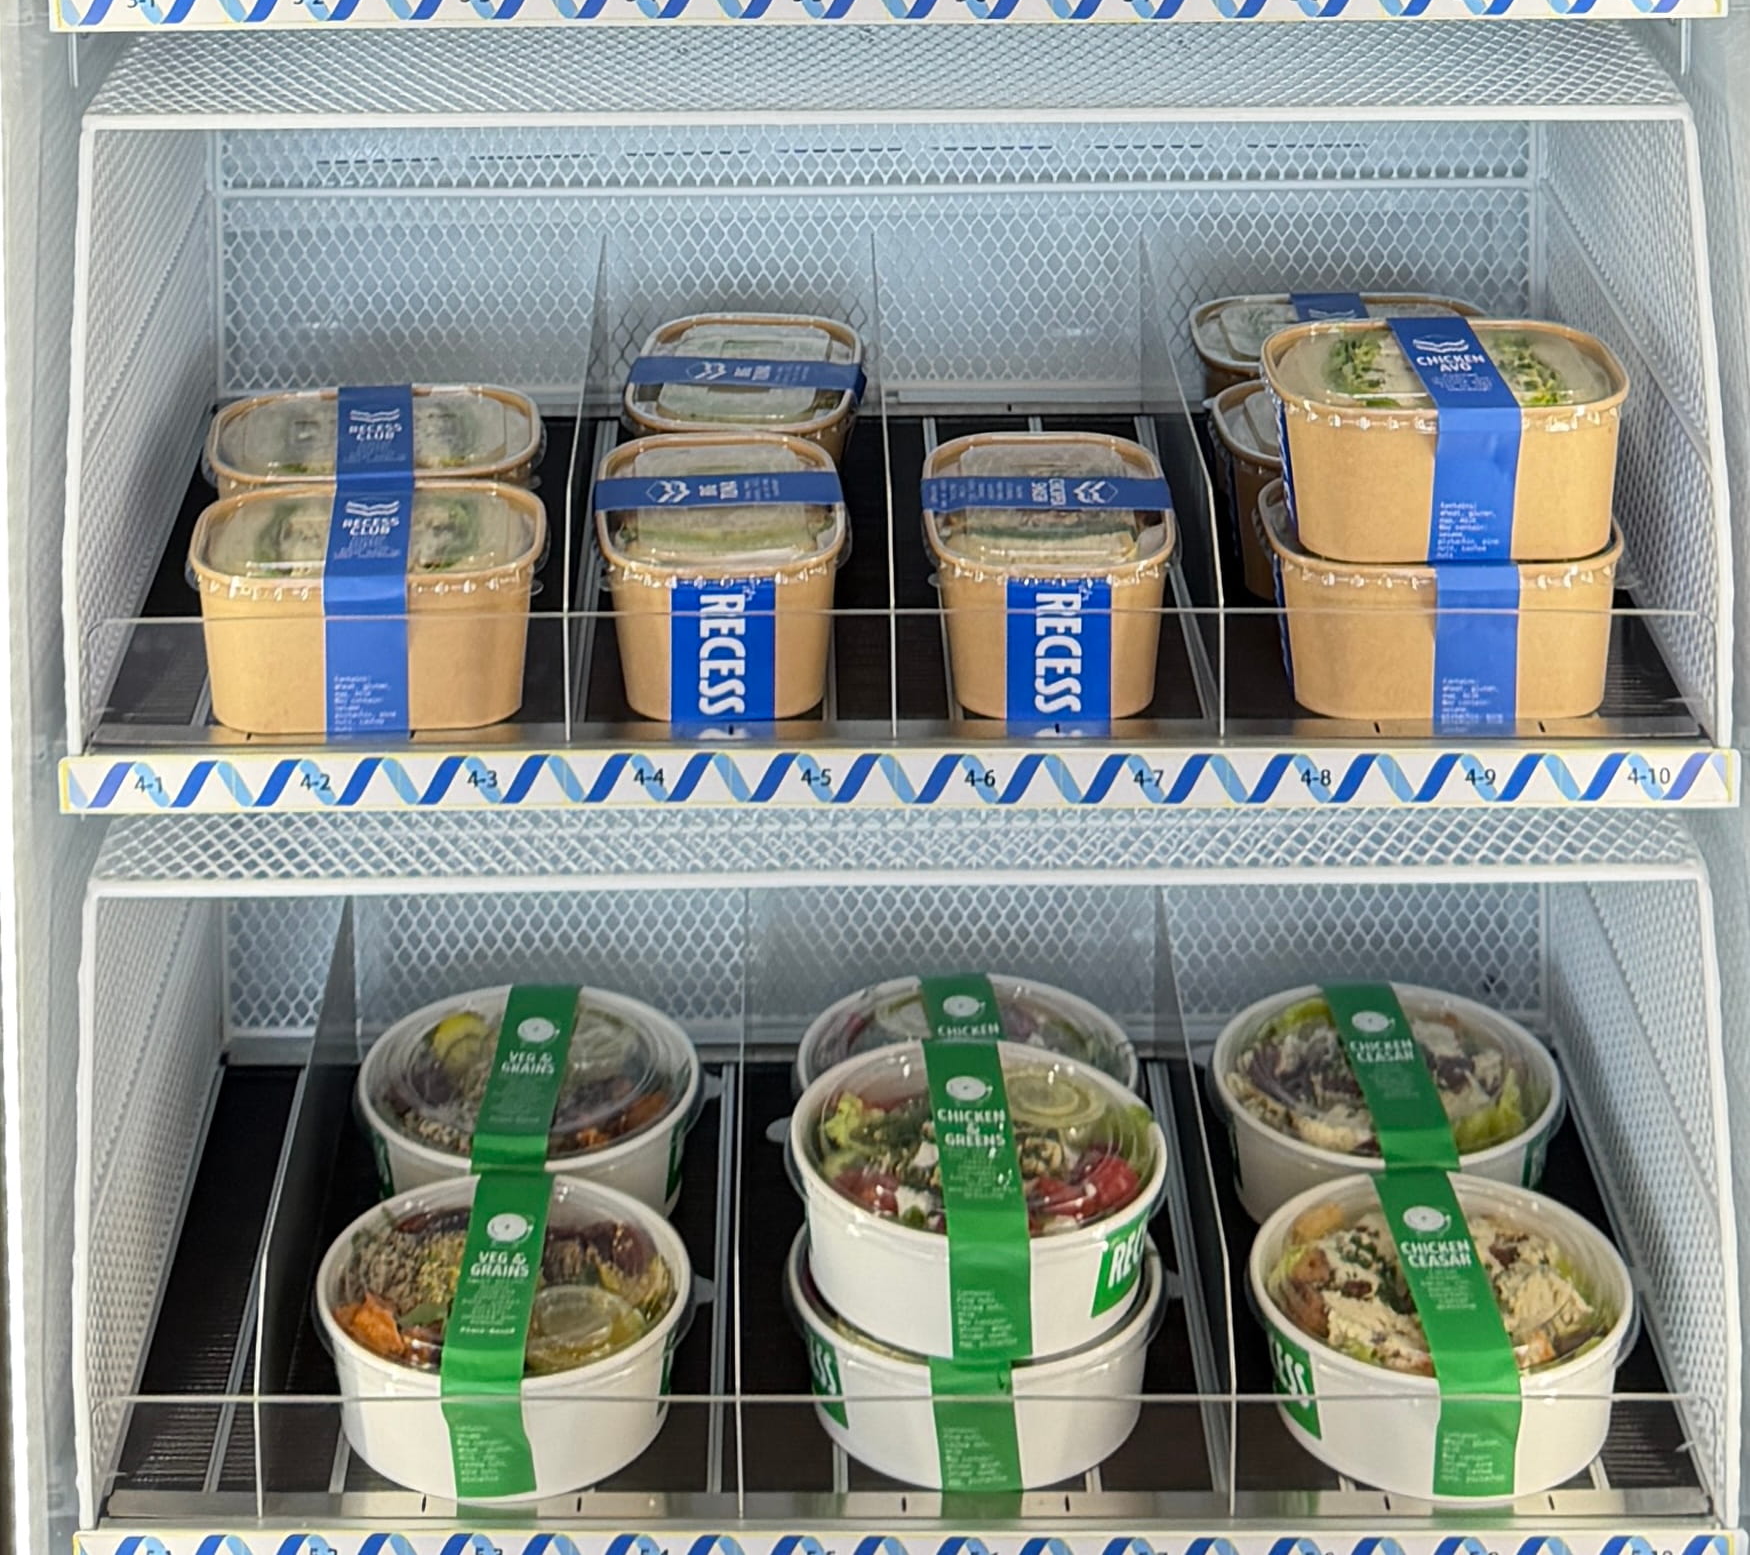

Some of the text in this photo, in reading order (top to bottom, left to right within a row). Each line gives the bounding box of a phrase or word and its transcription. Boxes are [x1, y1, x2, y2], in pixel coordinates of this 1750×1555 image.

[1416, 353, 1486, 367] CHICKEN
[1439, 361, 1473, 373] AVO
[341, 516, 400, 529] RECESS
[349, 526, 391, 536] CLUB
[699, 593, 746, 716] RECESS
[1034, 592, 1082, 714] RECESS
[300, 774, 331, 792] 4-2
[466, 771, 498, 788] 4-3
[633, 769, 665, 786] 4-4
[801, 769, 832, 787] 4-5
[964, 770, 996, 788] 4-6
[1133, 770, 1164, 788] 4-7
[1300, 769, 1332, 785] 4-8
[1464, 769, 1496, 786] 4-9
[1627, 767, 1671, 785] 4-10
[134, 776, 163, 793] 4-1
[937, 1022, 1000, 1037] CHICKEN
[1349, 1039, 1413, 1052] CHICKEN
[509, 1050, 536, 1064] VEG
[500, 1062, 556, 1075] GRAINS
[936, 1109, 1006, 1123] CHICKEN
[944, 1134, 1006, 1148] GREENS
[1400, 1239, 1470, 1255] CHICKEN
[478, 1251, 509, 1265] VEG
[1407, 1253, 1473, 1268] CEASAR
[470, 1263, 530, 1278] GRAINS
